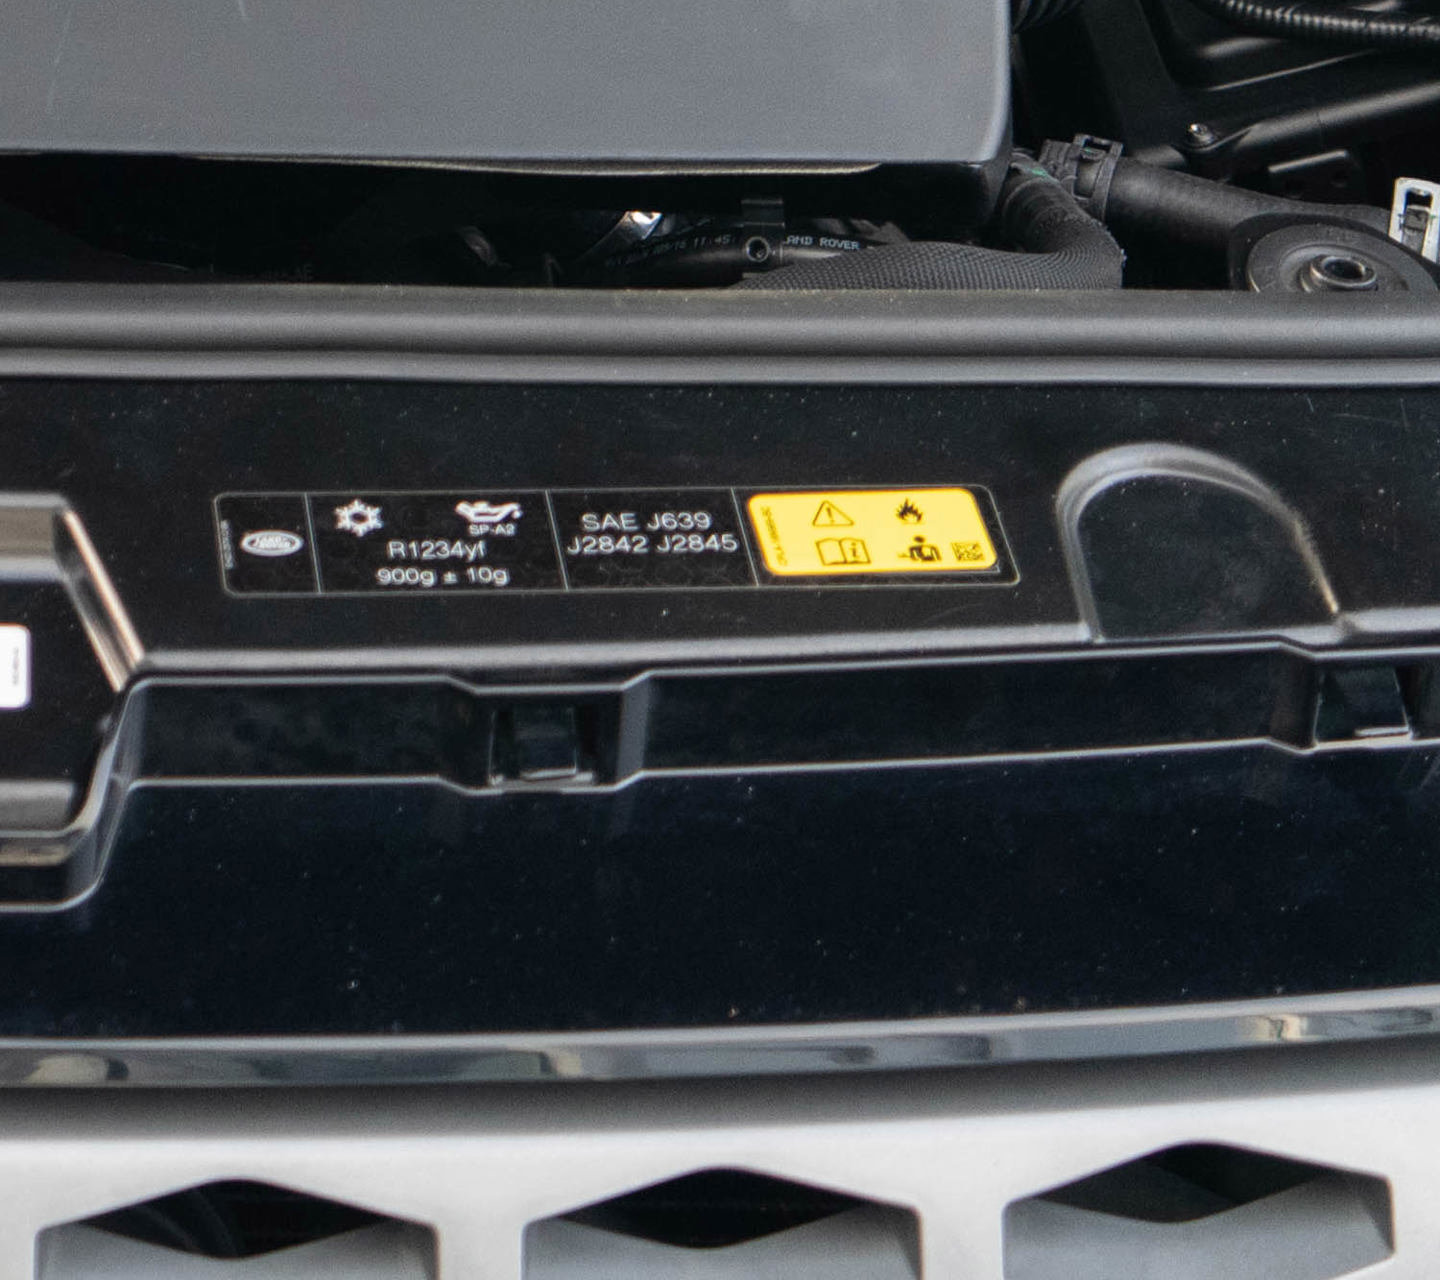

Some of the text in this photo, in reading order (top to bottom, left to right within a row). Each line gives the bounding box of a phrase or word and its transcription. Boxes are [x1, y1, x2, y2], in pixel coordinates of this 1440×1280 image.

[820, 238, 860, 250] ROVER
[468, 523, 515, 536] SP-A2
[581, 511, 712, 531] SAE J639
[387, 540, 486, 562] R1234yf
[568, 533, 738, 555] J2842 J2845
[376, 567, 434, 587] 900g
[466, 567, 509, 587] 10g
